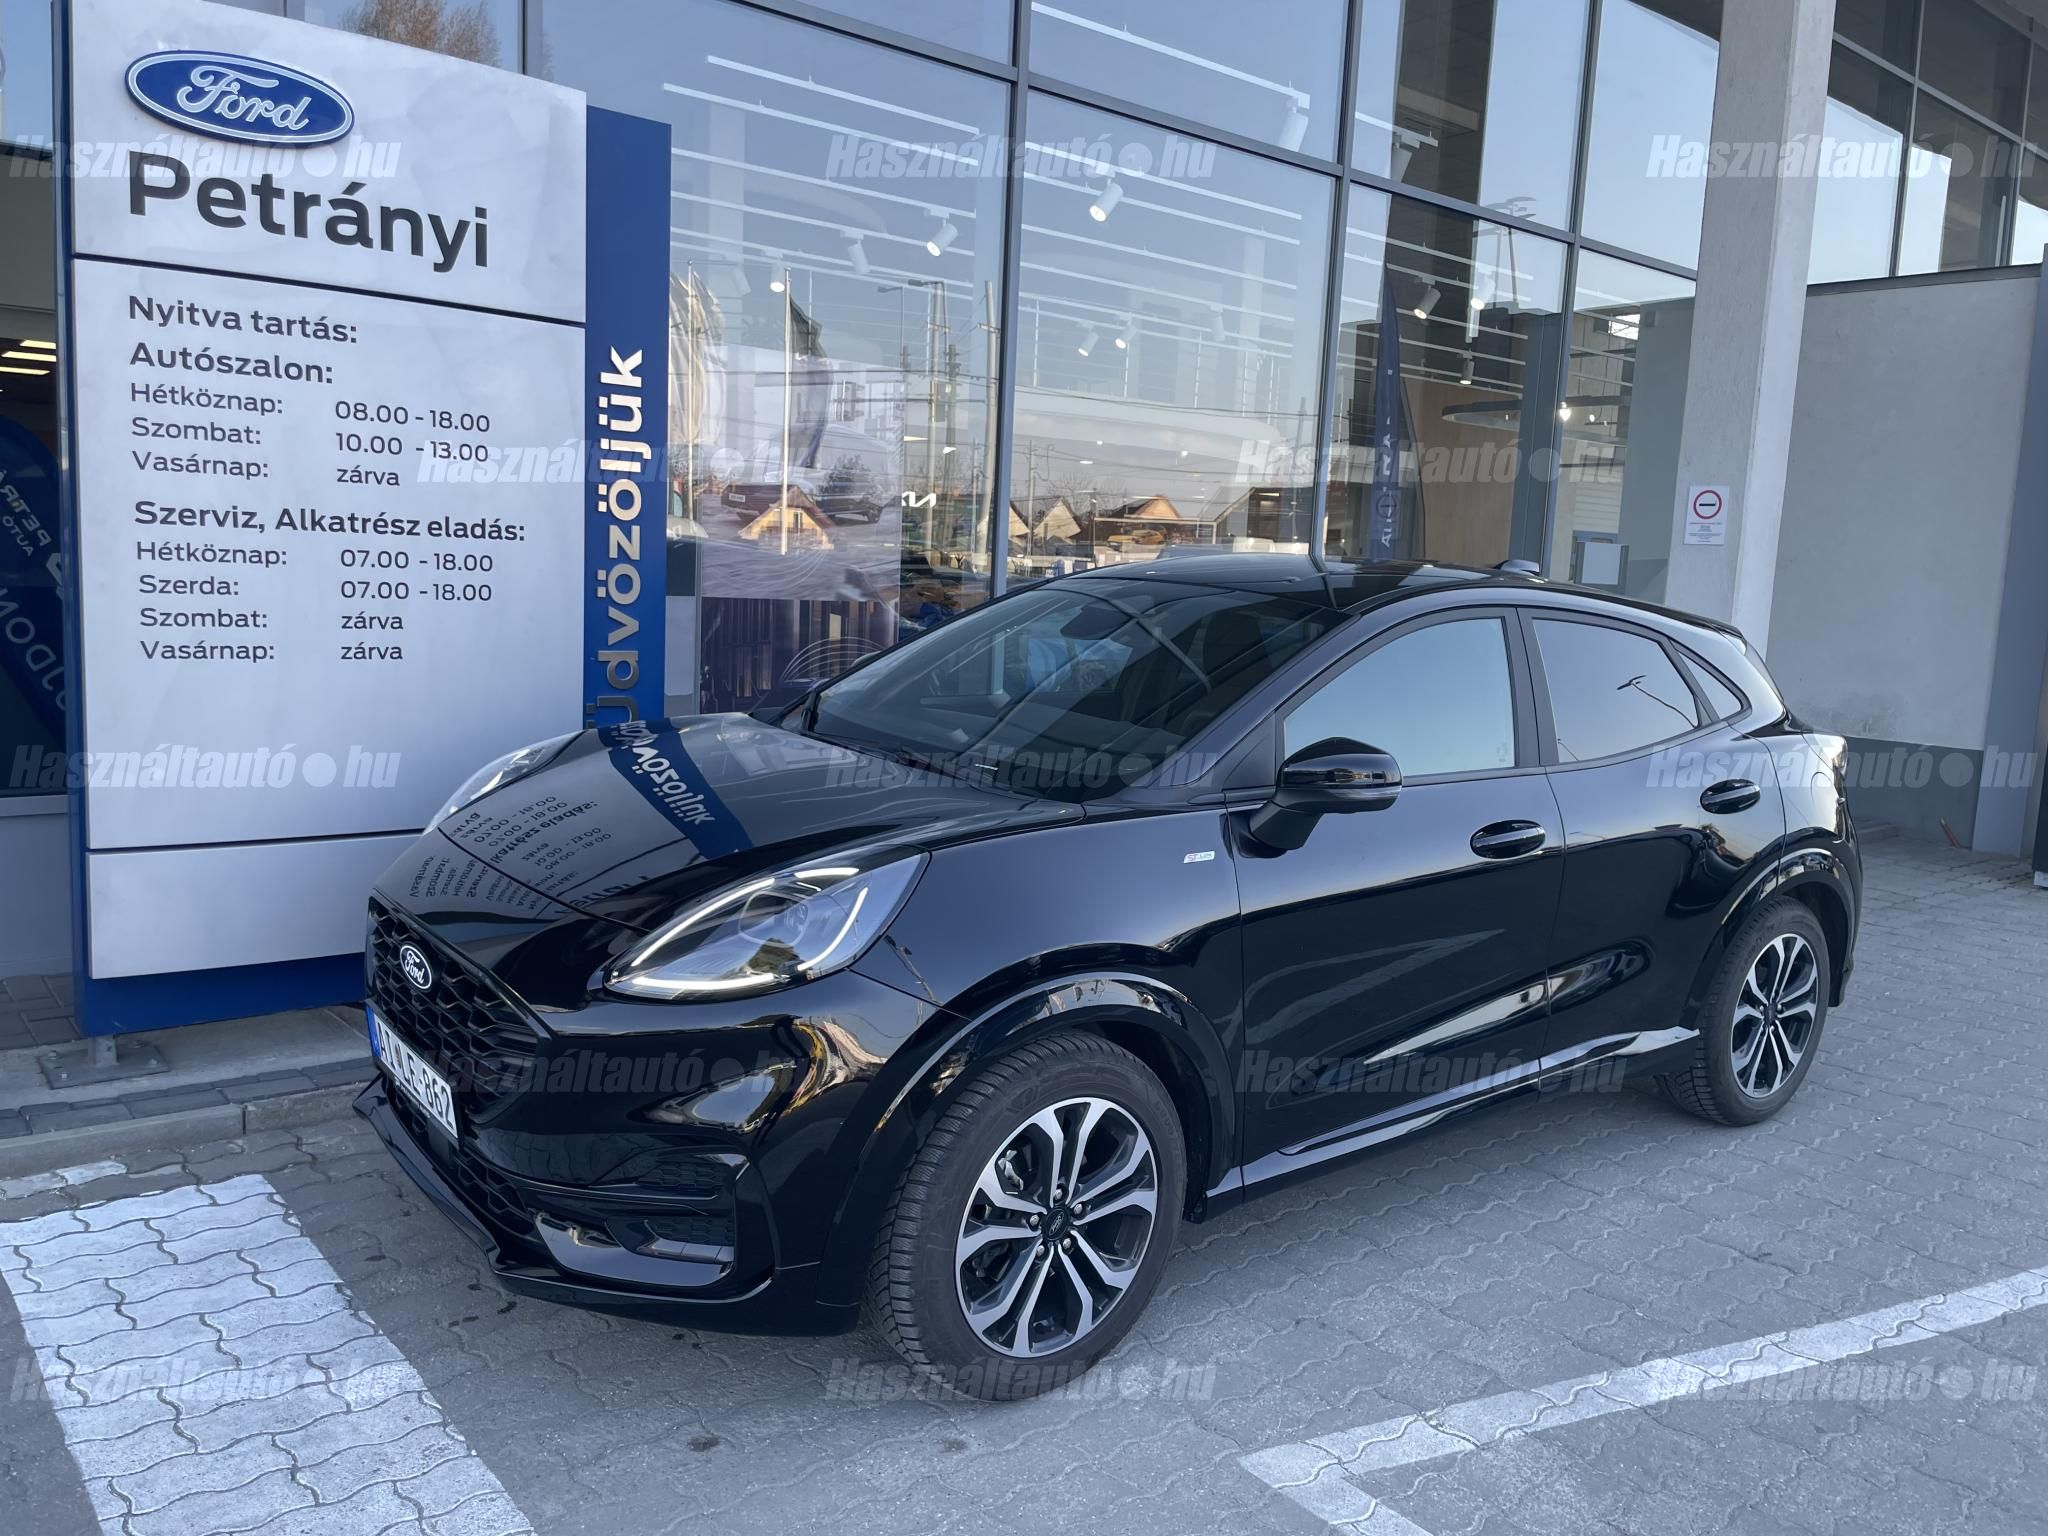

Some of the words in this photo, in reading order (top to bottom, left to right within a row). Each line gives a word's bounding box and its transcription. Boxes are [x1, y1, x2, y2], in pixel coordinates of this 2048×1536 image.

[177, 65, 312, 131] Ford
[129, 150, 488, 273] Petrányi
[129, 295, 242, 331] Nyitva
[250, 310, 357, 343] tartás:
[130, 342, 333, 384] Autószalon:
[131, 382, 283, 416] Hétköznap:
[335, 400, 409, 425] 08.00
[132, 416, 261, 445] Szombat:
[335, 432, 403, 456] 10.00
[132, 450, 268, 480] Vasárnap:
[336, 464, 400, 487] zárva
[134, 500, 266, 534] Szerviz,
[275, 507, 421, 537] Alkatrész
[427, 515, 525, 542] eladás:
[585, 344, 652, 731] Üdvözöljük
[136, 541, 287, 569] Hétköznap:
[340, 548, 409, 569] 07.00
[139, 574, 239, 596] Szerda:
[340, 580, 409, 600] 07.00
[139, 607, 267, 628] Szombat:
[341, 610, 404, 630] zárva
[139, 640, 275, 664] Vasárnap:
[340, 641, 404, 660] zárva
